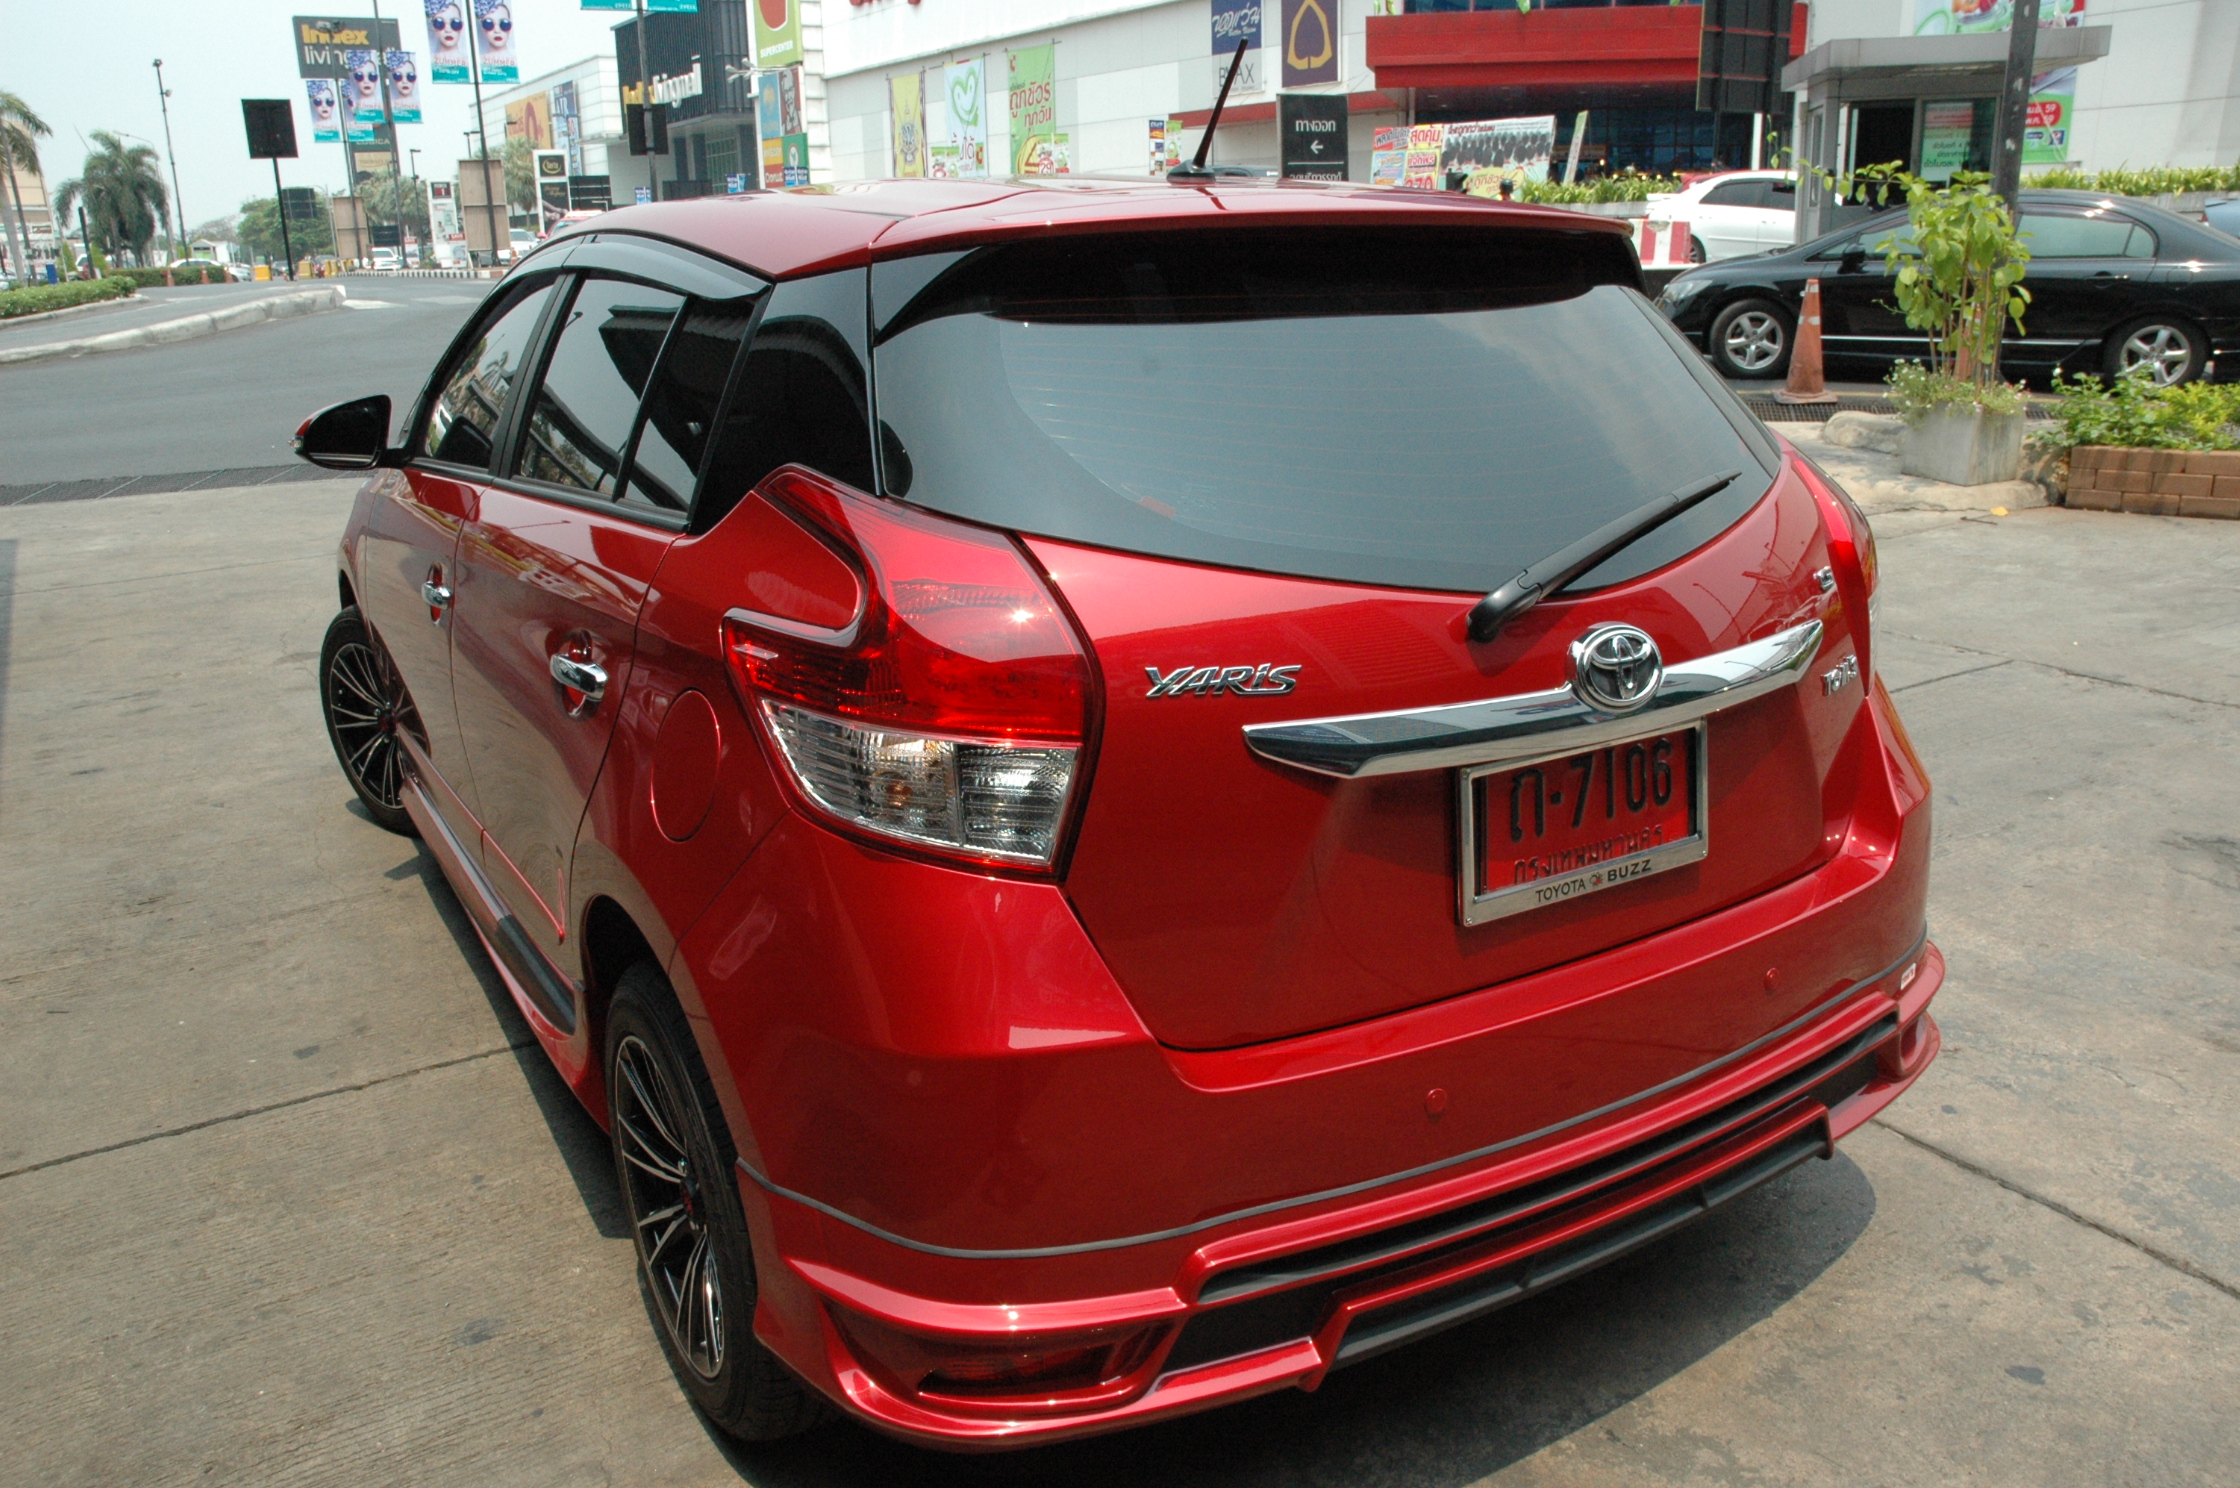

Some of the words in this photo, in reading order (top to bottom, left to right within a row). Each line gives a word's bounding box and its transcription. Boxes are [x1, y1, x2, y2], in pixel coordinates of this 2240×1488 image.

[760, 40, 794, 58] SUPERCENTER
[1295, 120, 1336, 132] ทางออก
[1536, 879, 1586, 903] TOYOTA
[1607, 858, 1652, 882] BUZZ
